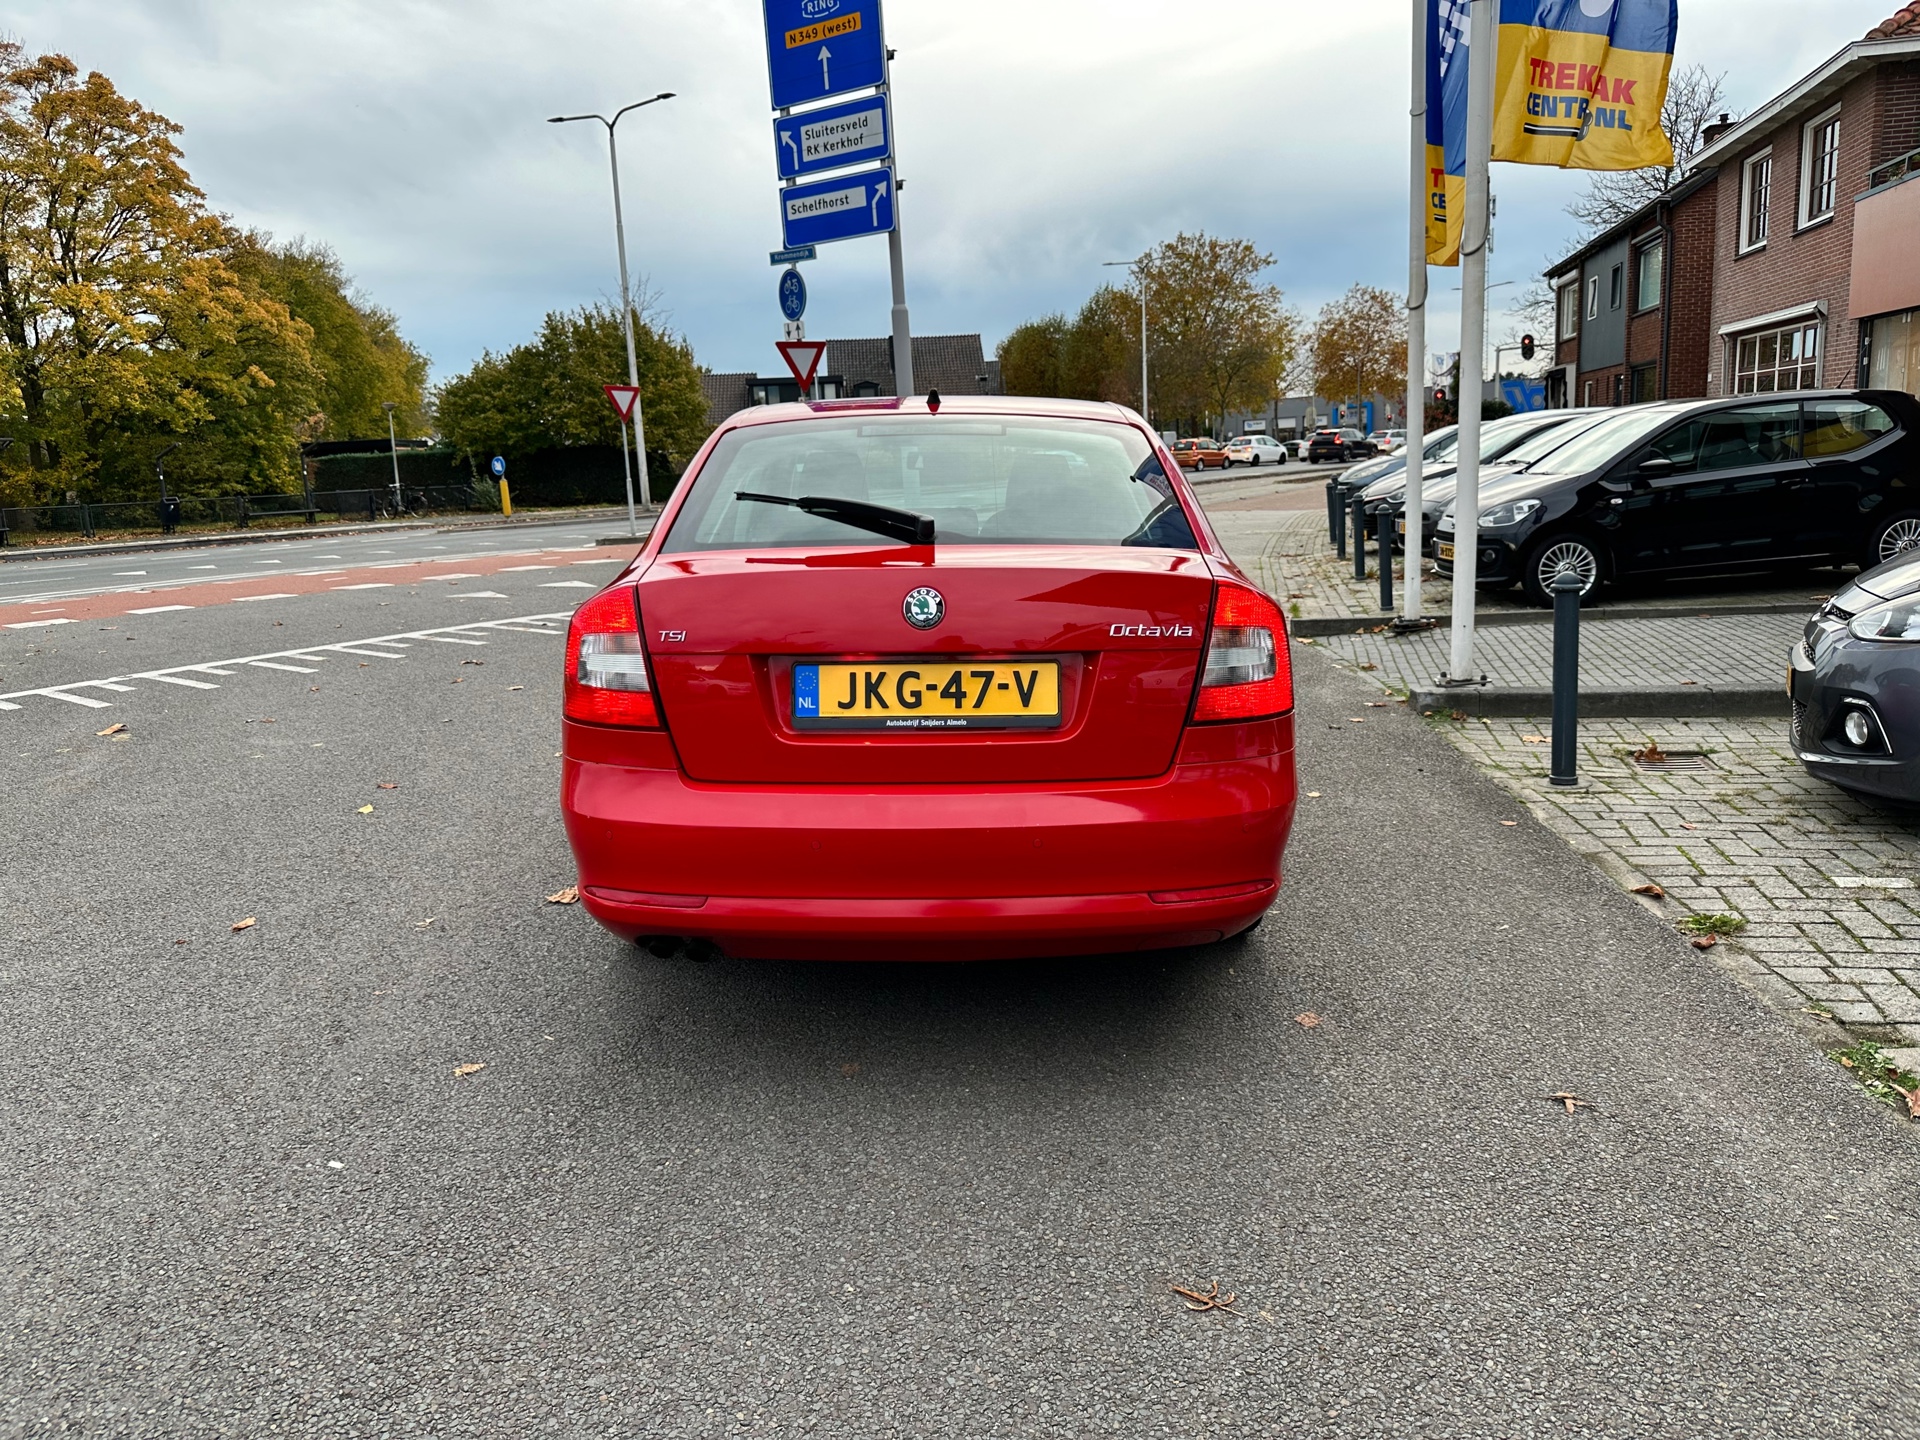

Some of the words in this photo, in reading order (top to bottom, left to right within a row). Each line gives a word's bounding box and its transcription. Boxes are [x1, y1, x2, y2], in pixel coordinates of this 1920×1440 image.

[807, 0, 834, 13] RING
[822, 16, 857, 38] (west)
[804, 115, 868, 141] Sluitersveld
[806, 143, 820, 156] RK
[823, 132, 864, 153] Kerkhof
[790, 193, 850, 215] Schelfhorst
[658, 630, 687, 642] TSI
[1109, 623, 1193, 637] Octavia
[837, 670, 1039, 710] JKG-47-V
[798, 696, 816, 709] NL
[886, 719, 919, 727] Autobedrijf
[920, 719, 945, 727] Snijders
[946, 718, 967, 726] Almelo
